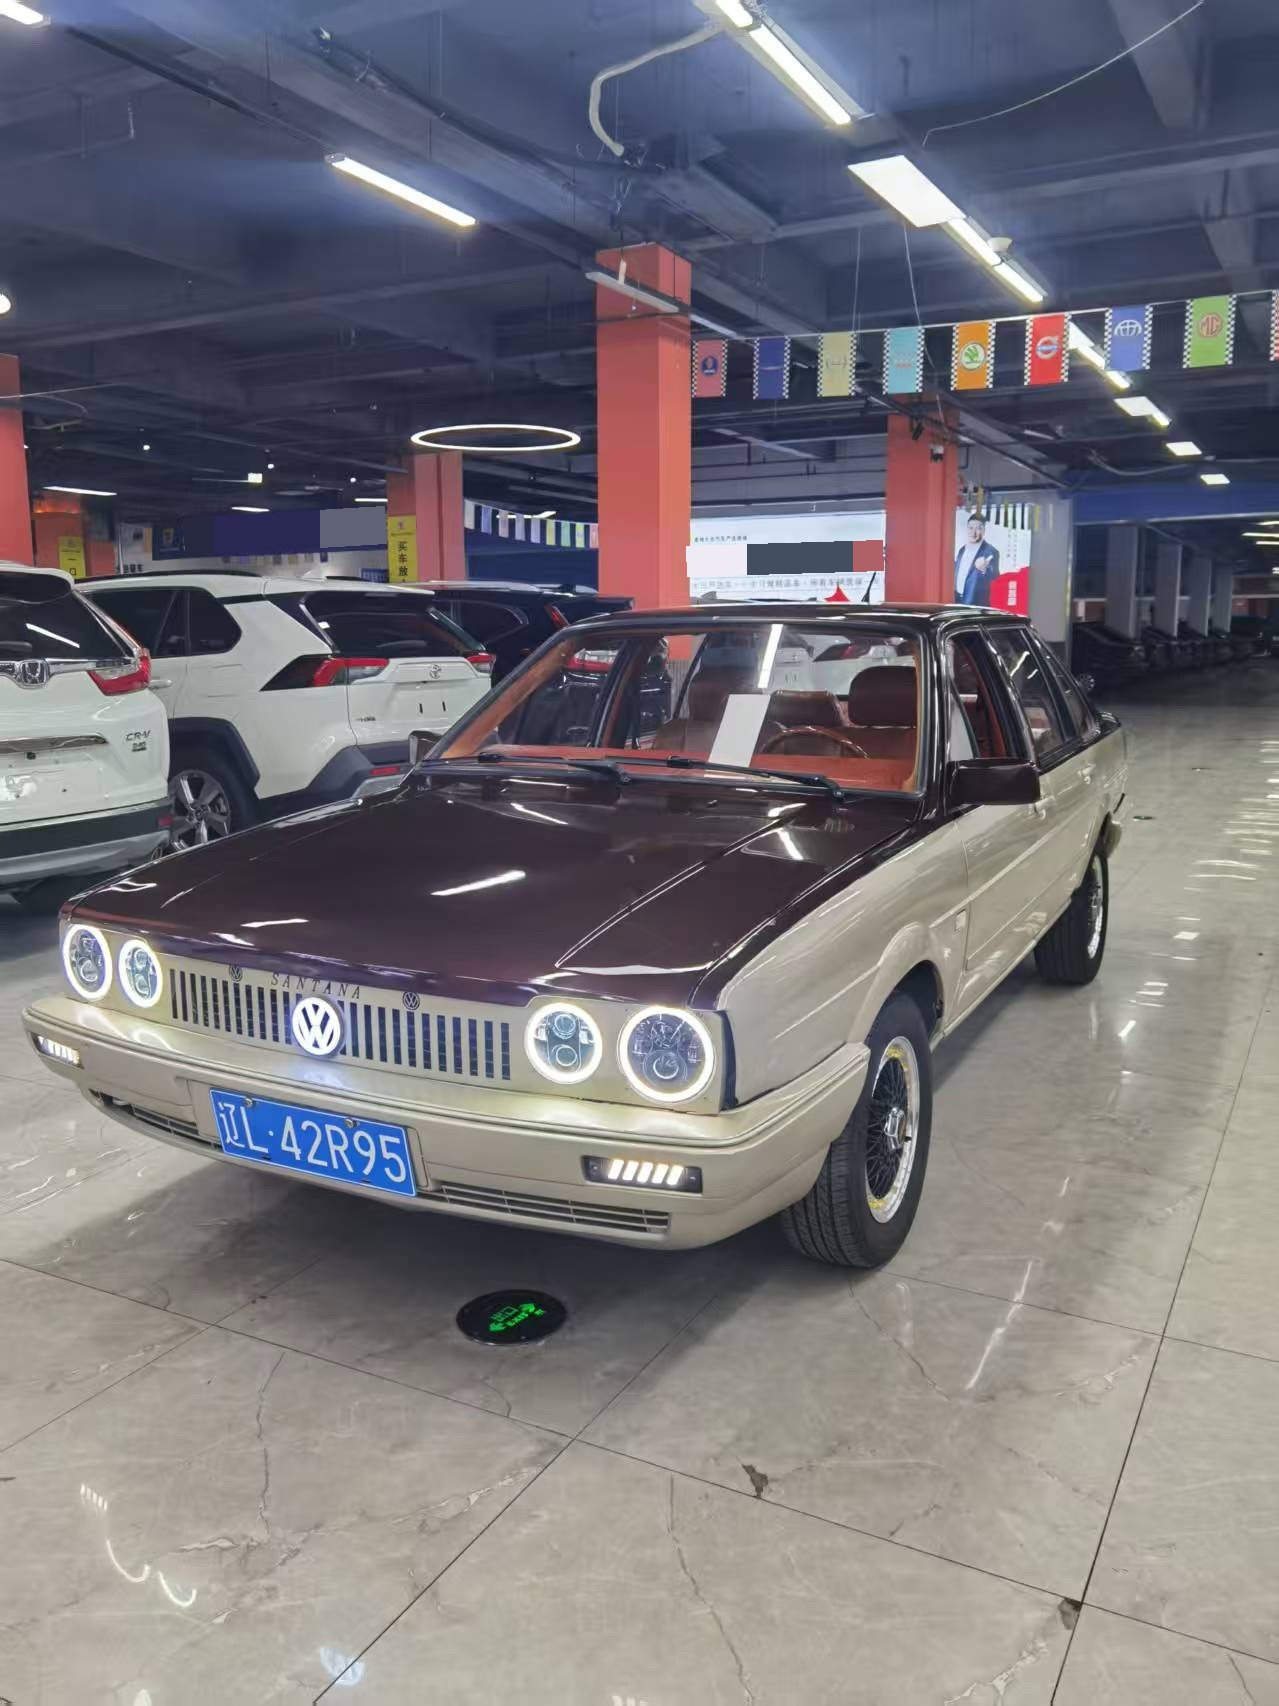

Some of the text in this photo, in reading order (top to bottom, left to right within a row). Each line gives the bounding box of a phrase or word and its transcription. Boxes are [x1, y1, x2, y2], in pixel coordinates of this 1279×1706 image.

[398, 540, 409, 583] 买车放
[270, 972, 361, 1000] SANTANA
